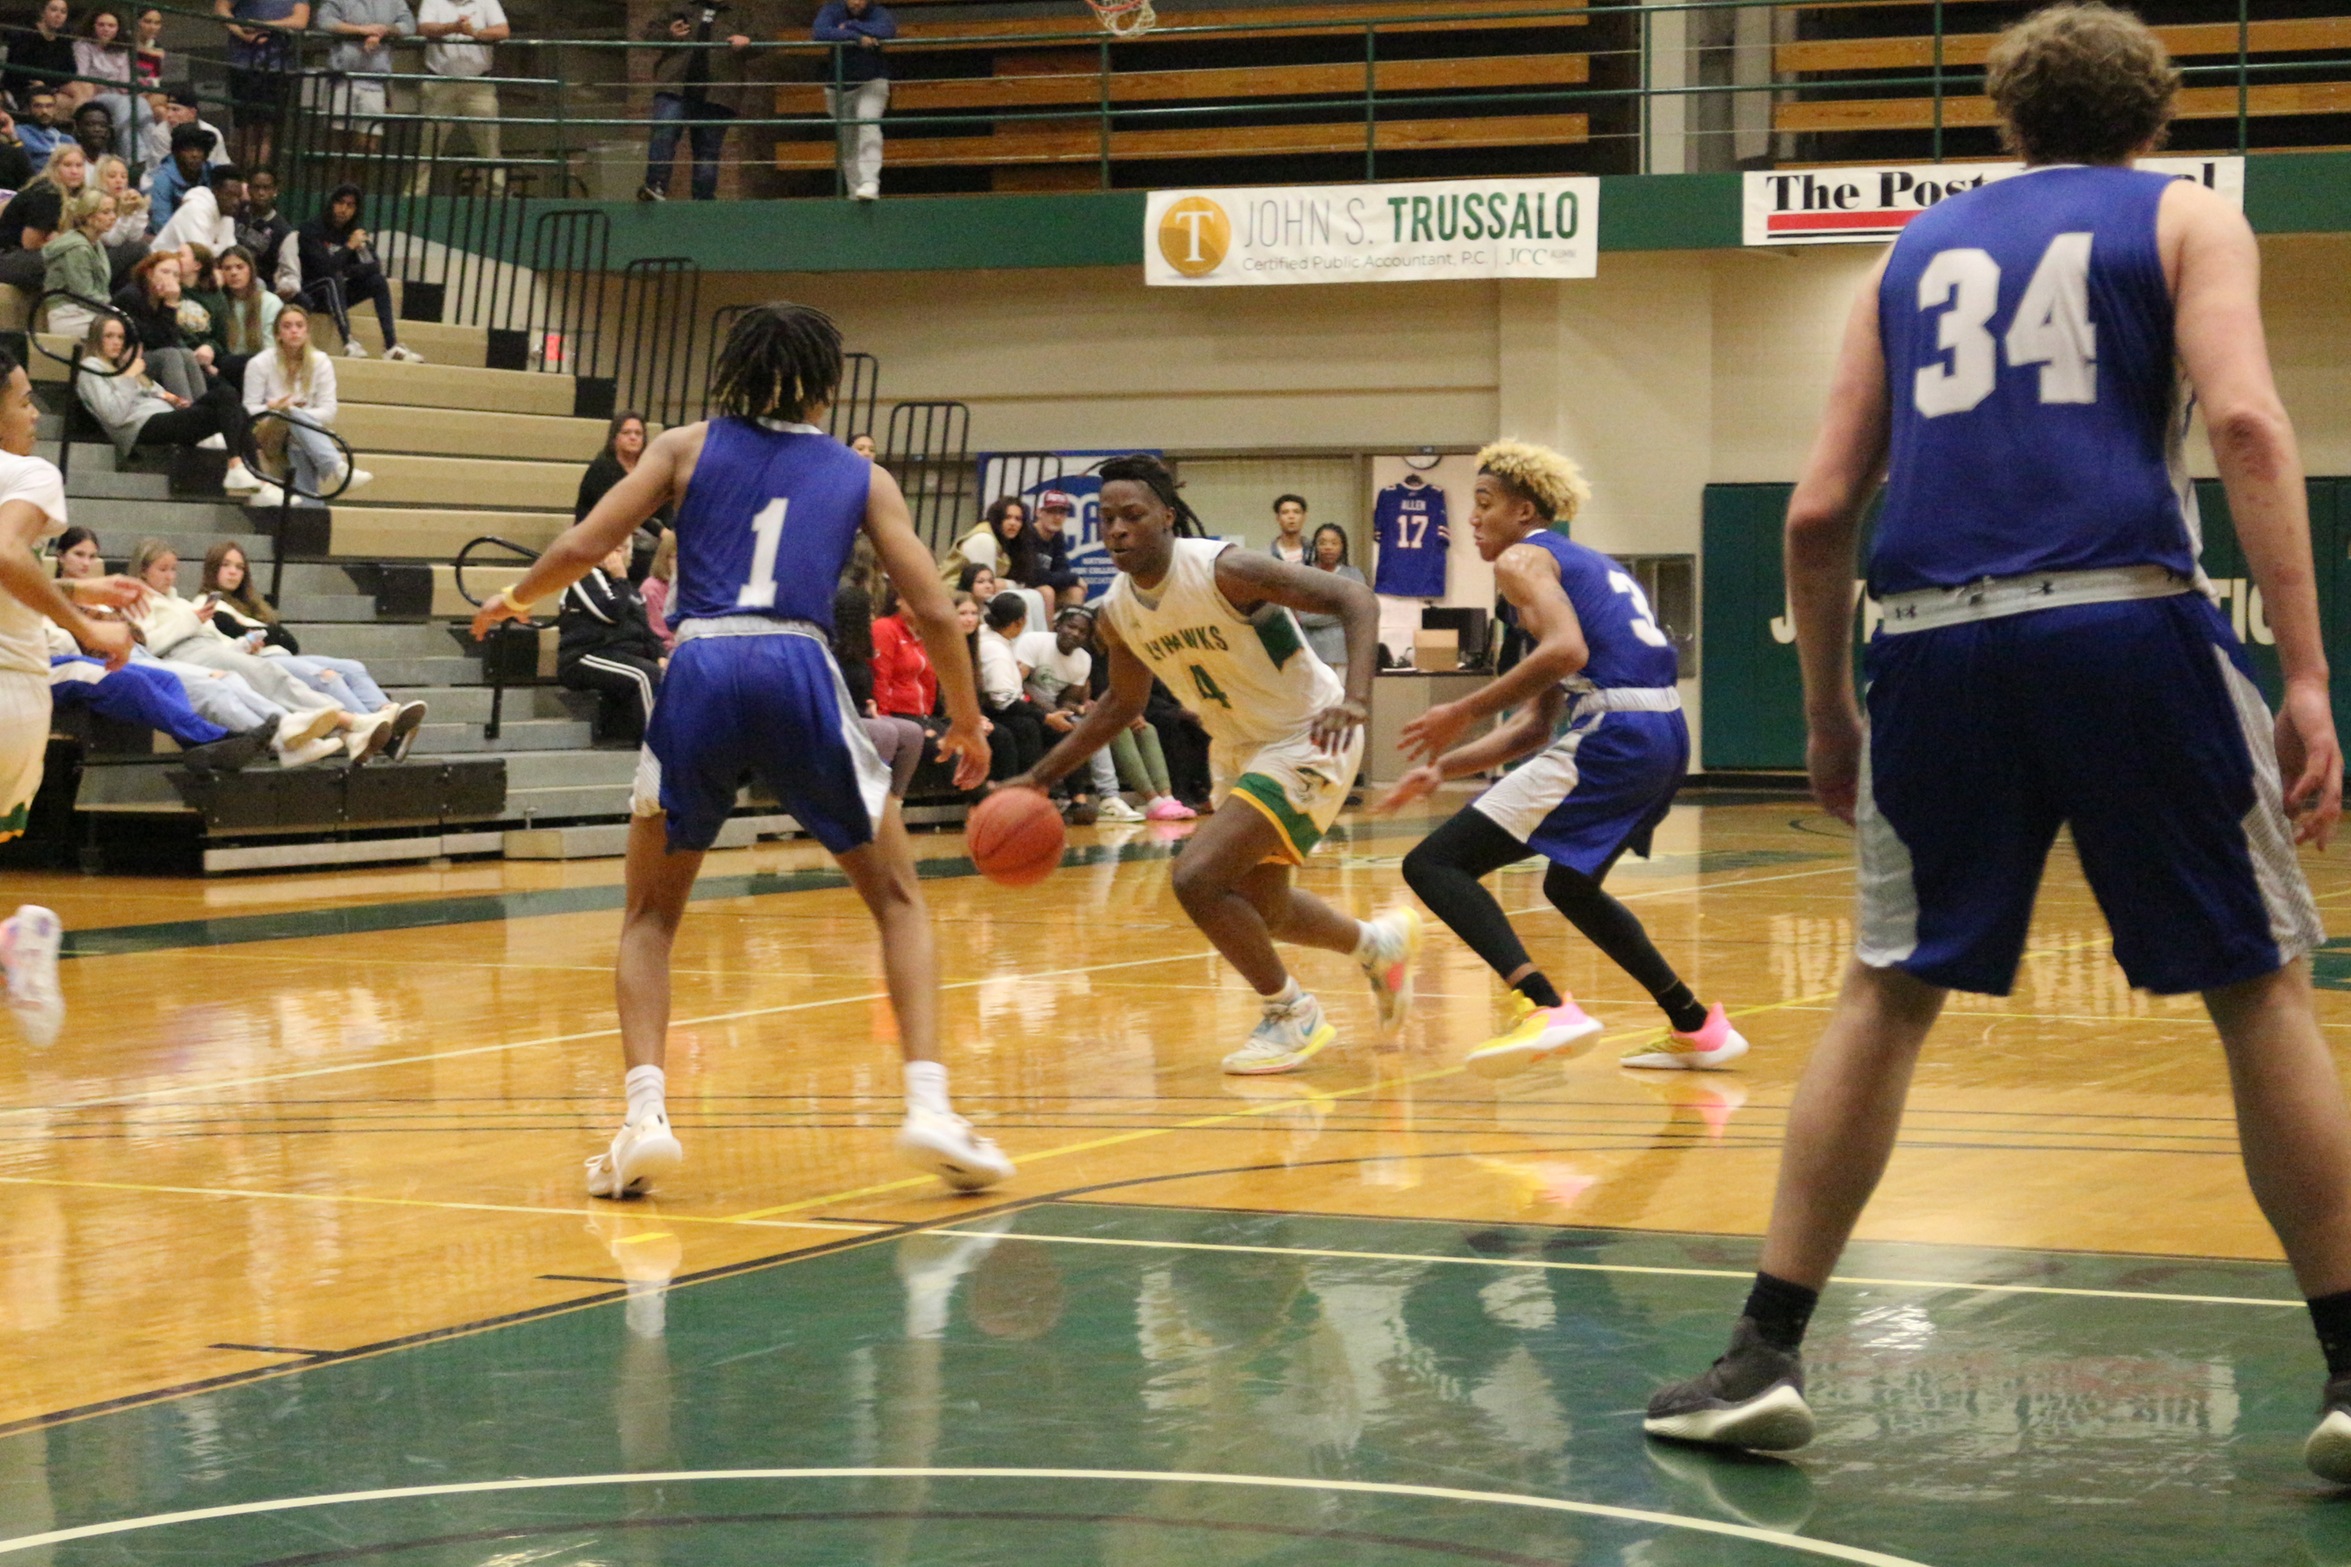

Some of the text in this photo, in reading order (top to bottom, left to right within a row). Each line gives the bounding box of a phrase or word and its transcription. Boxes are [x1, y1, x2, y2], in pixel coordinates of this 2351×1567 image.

[1766, 174, 1860, 212] The
[1175, 210, 1214, 262] T
[1244, 190, 1579, 248] JOHN S. TRUSSALO
[1243, 250, 1489, 272] Certified Public Accountant, P.C.
[1506, 247, 1548, 266] JCC
[1914, 231, 2098, 420] 34
[1401, 499, 1427, 512] ALLEN
[736, 496, 790, 608] 1
[1396, 514, 1430, 549] 17
[1607, 568, 1669, 648] 3
[1189, 663, 1233, 710] 4
